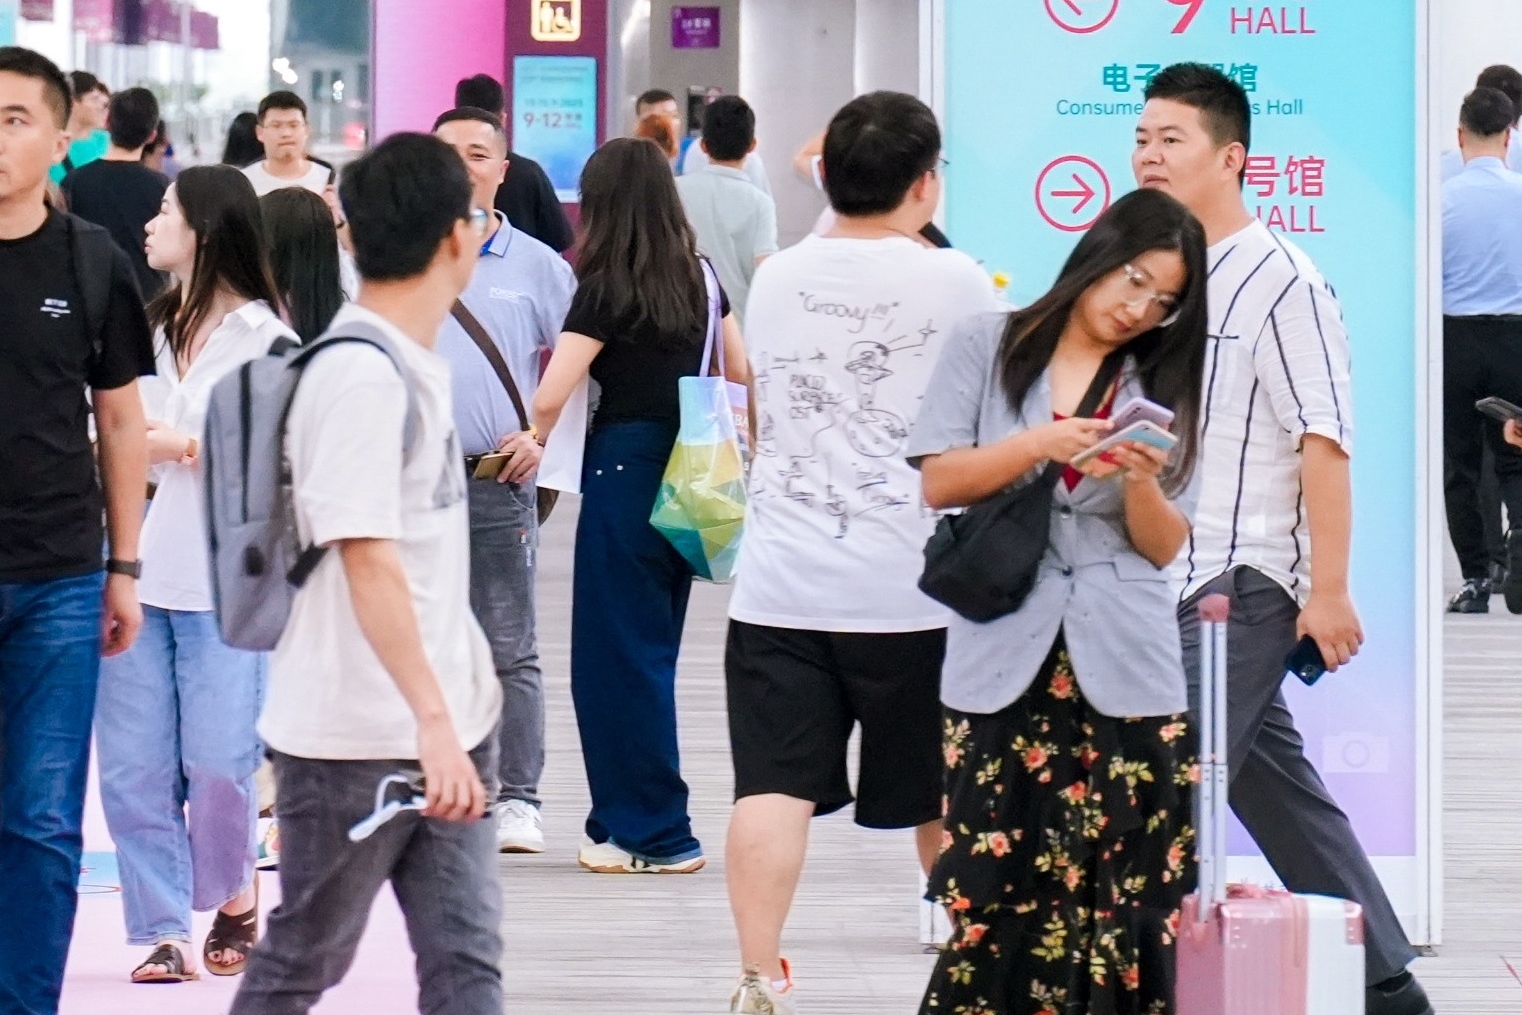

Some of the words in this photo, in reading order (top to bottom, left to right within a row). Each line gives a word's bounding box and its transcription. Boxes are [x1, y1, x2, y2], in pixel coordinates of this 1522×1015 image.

[1231, 7, 1316, 34] HALL
[1056, 99, 1144, 115] Consume
[1267, 99, 1303, 115] Hall
[1244, 155, 1325, 197] 号馆
